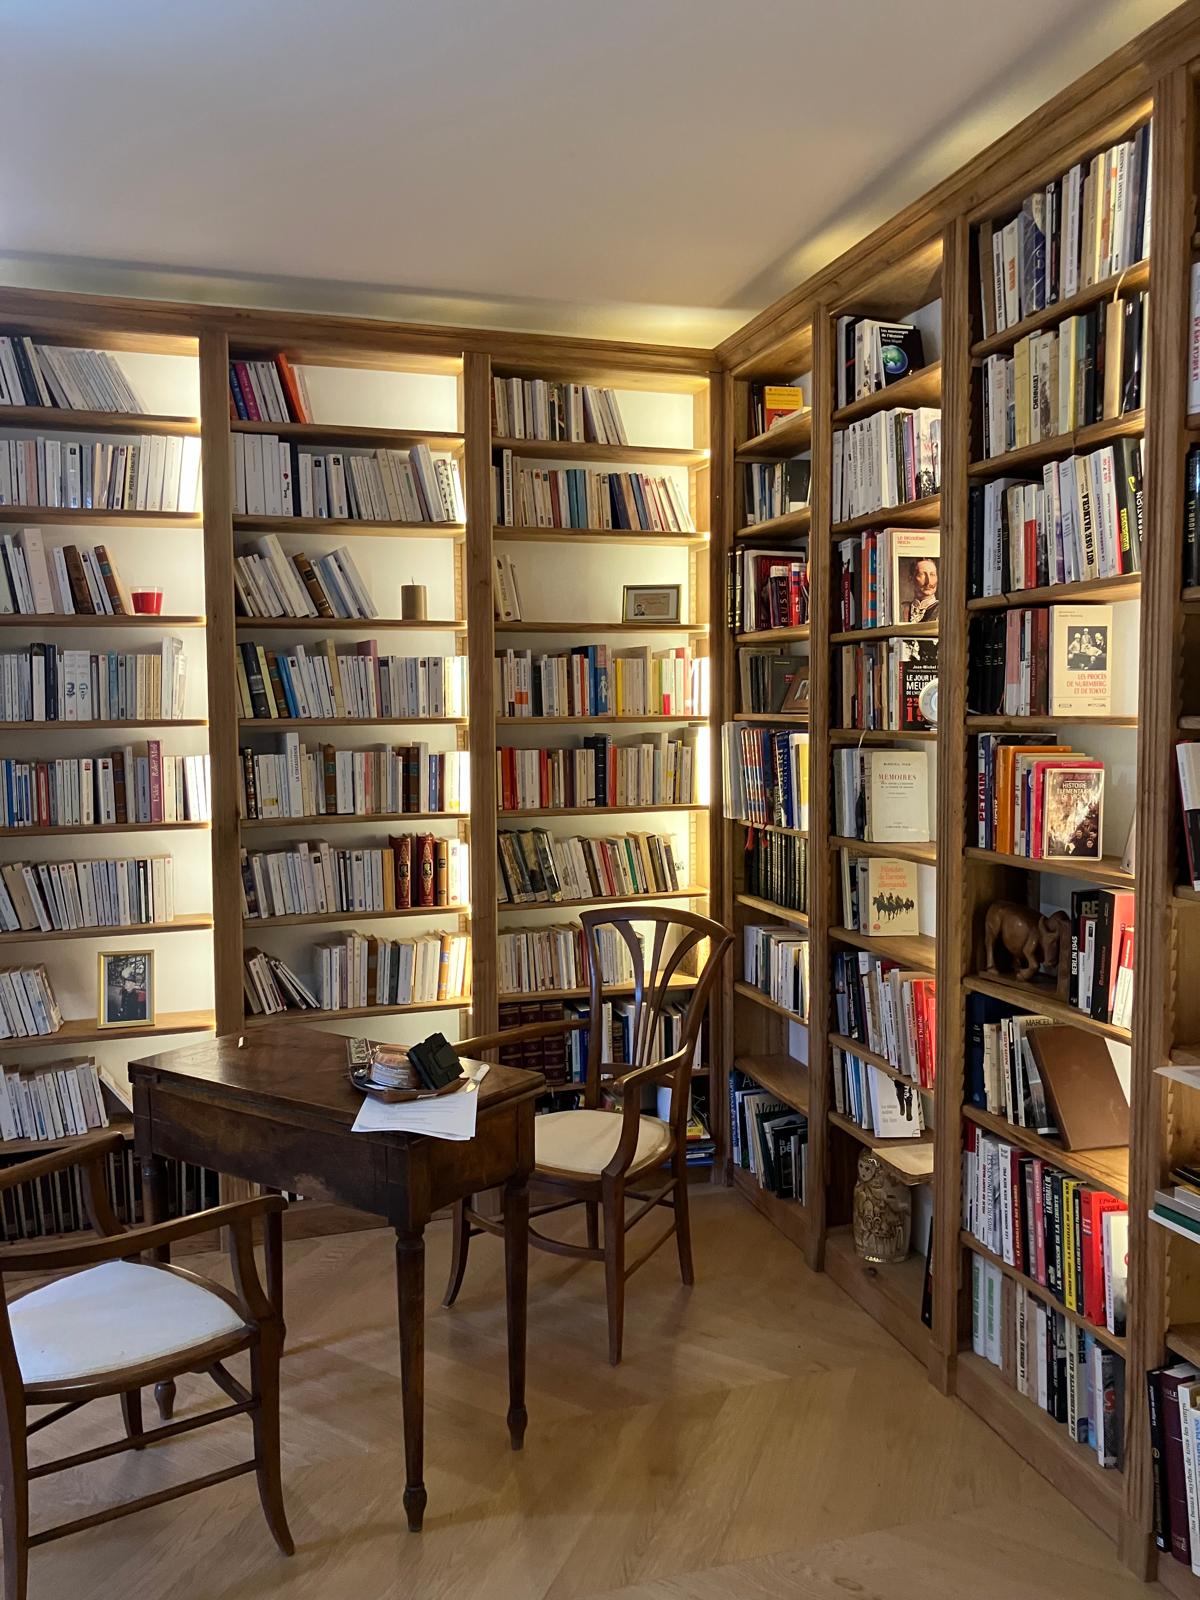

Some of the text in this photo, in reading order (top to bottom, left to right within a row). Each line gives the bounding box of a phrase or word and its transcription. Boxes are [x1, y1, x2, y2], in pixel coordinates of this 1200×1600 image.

[1081, 492, 1091, 532] VAINCRA
[1085, 532, 1093, 549] OSE
[1086, 550, 1095, 566] QUI
[779, 580, 788, 623] RUSSE
[1075, 680, 1107, 688] NUREMBERG
[1088, 687, 1107, 695] TOKYO
